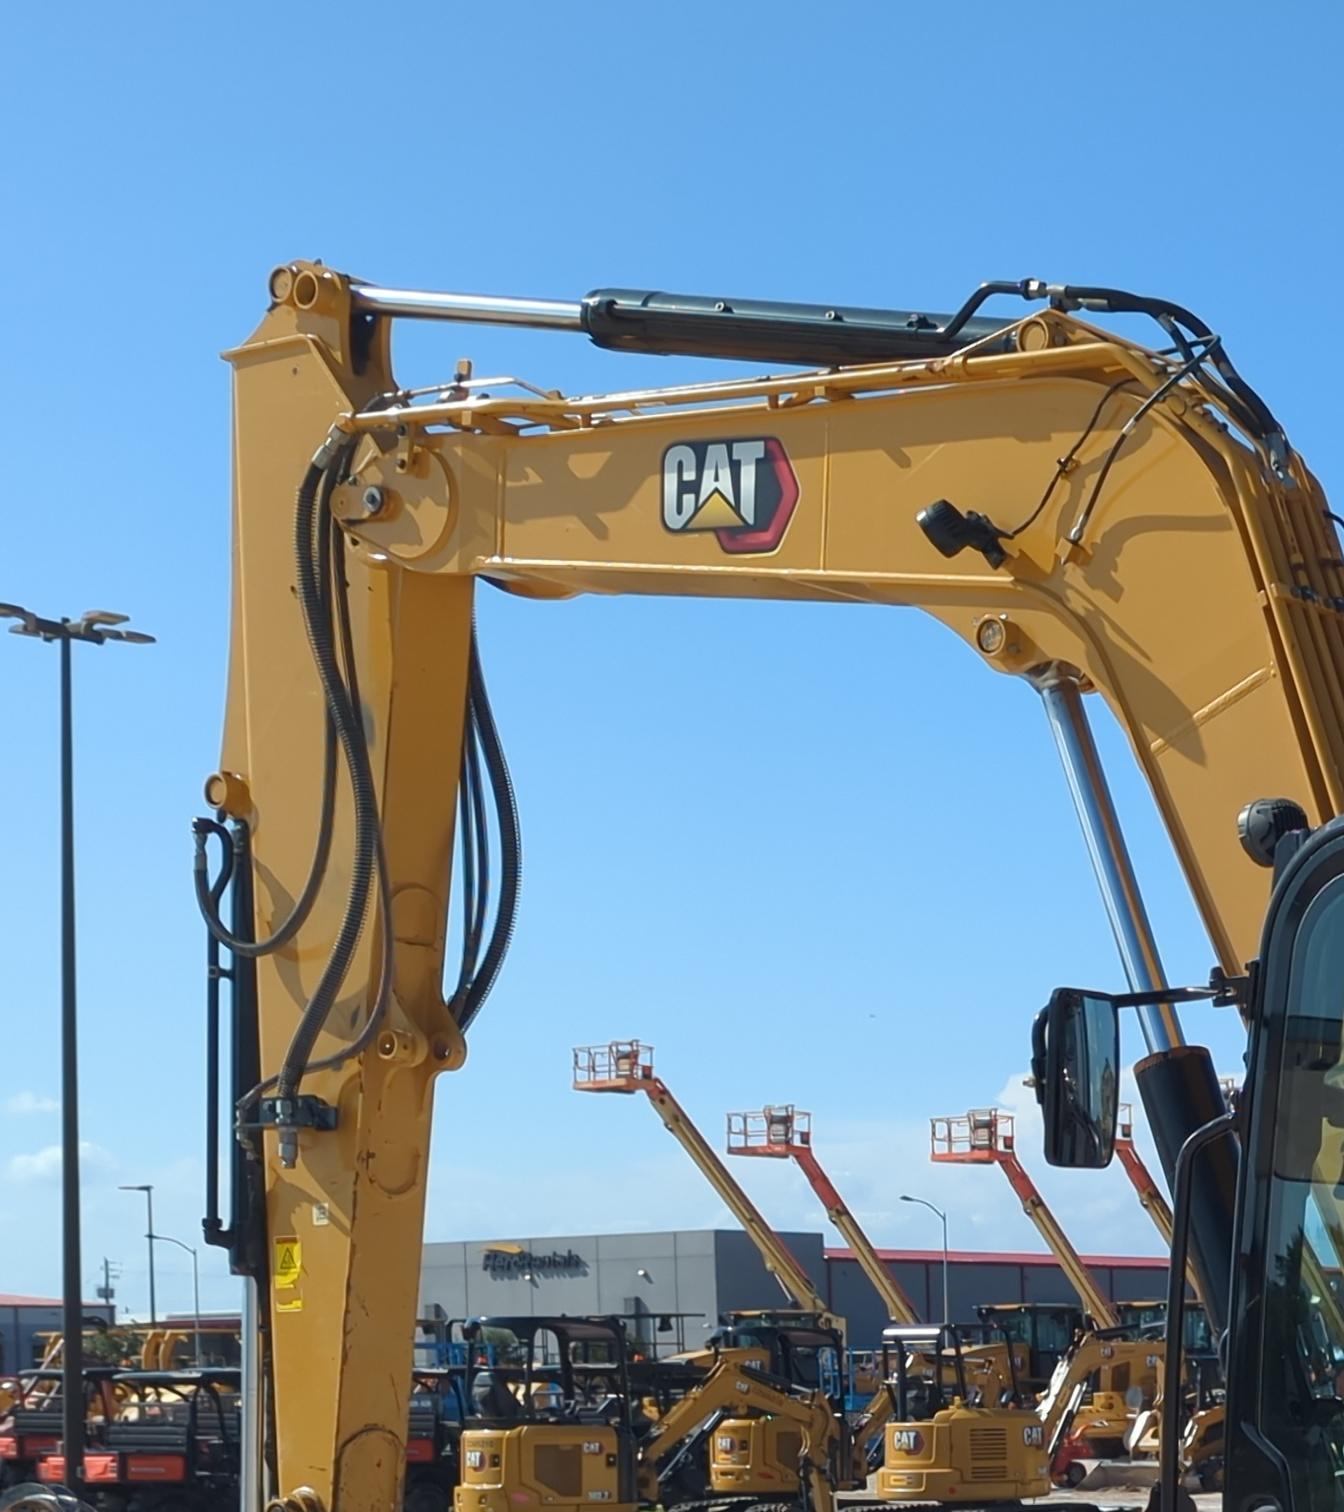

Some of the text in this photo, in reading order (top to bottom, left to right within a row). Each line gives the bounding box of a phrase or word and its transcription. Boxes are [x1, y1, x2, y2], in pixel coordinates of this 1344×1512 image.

[664, 441, 765, 529] CAT
[894, 1430, 917, 1450] CAT
[1023, 1426, 1043, 1446] CAT
